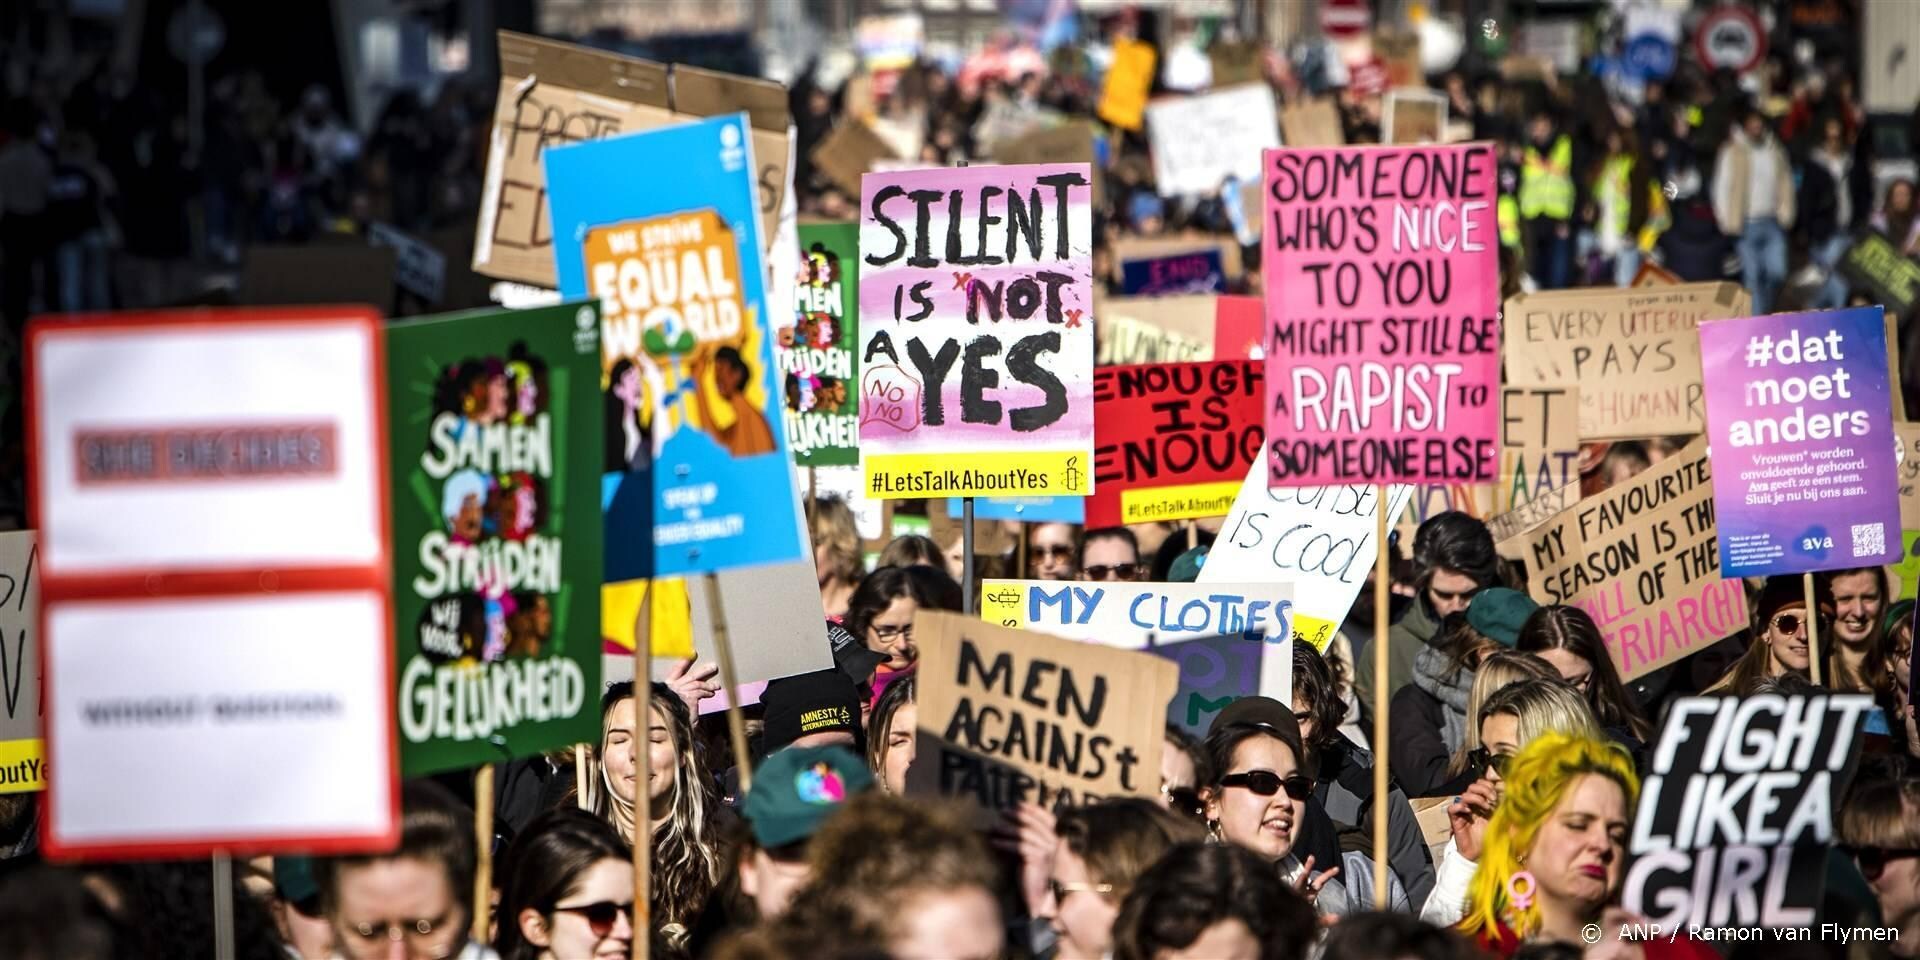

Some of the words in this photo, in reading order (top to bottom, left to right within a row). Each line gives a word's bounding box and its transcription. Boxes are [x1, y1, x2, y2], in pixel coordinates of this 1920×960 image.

[1271, 149, 1490, 202] SOMEONE
[864, 172, 1091, 267] SILENT
[1274, 204, 1379, 254] WHO'S
[1391, 201, 1489, 254] NICE
[592, 245, 736, 318] EQUAL
[793, 282, 844, 318] MEN
[894, 280, 935, 325] IS
[966, 271, 1077, 325] NOT
[1302, 261, 1362, 308] TO
[1373, 258, 1451, 307] YOU
[1272, 318, 1374, 357] MIGHT
[1380, 315, 1452, 357] STILL
[1458, 316, 1495, 356] BE
[1526, 310, 1607, 343] EVERY
[1572, 339, 1677, 381] PAYS
[1744, 329, 1844, 369] #dat
[864, 330, 900, 365] A
[906, 331, 1070, 433] YES
[871, 379, 904, 403] NO
[1274, 394, 1289, 419] A
[1291, 362, 1463, 434] RAPIST
[1458, 384, 1488, 408] TO
[1744, 367, 1851, 407] moet
[875, 402, 904, 422] NO
[1151, 396, 1231, 435] IS
[1502, 389, 1566, 448] ET
[1600, 386, 1680, 425] HUMAN
[420, 411, 553, 479] SAMEN
[1729, 407, 1872, 449] anders
[1095, 426, 1265, 485] ENOUG
[1272, 437, 1418, 480] SOMEONE
[1424, 436, 1493, 480] ELSE
[1740, 463, 1815, 480] onvoldoende
[1816, 458, 1868, 475] gehoord.
[1811, 447, 1854, 460] worden
[871, 468, 1049, 493] #LetsTalkAboutYes
[1745, 494, 1772, 505] Sluit
[1773, 493, 1785, 505] je
[1786, 493, 1801, 501] nu
[1803, 490, 1818, 501] bij
[1819, 489, 1841, 499] ons
[1842, 486, 1868, 496] aan.
[1749, 481, 1769, 492] Ava
[1770, 478, 1797, 491] geeft
[1799, 478, 1811, 487] ze
[1812, 475, 1832, 486] een
[1833, 473, 1863, 484] stem.
[1532, 524, 1566, 572] MY
[1579, 457, 1711, 543] FAVOURITE
[1229, 510, 1269, 548] IS
[1272, 523, 1370, 584] COOL
[1543, 532, 1640, 608] SEASON
[1652, 520, 1676, 555] IS
[1680, 496, 1716, 538] TH
[1802, 536, 1834, 551] ava
[1638, 562, 1667, 606] OF
[1675, 536, 1719, 585] THE
[1028, 586, 1105, 625] MY
[1606, 578, 1746, 673] RIARCHY
[956, 637, 1108, 730] MEN
[800, 707, 838, 725] AMNESTY
[801, 718, 841, 732] INTERNATIONAL
[1652, 693, 1874, 775] FIGHT
[1629, 770, 1801, 855] LIKE
[1781, 769, 1834, 844] A
[1621, 843, 1816, 937] GIRL
